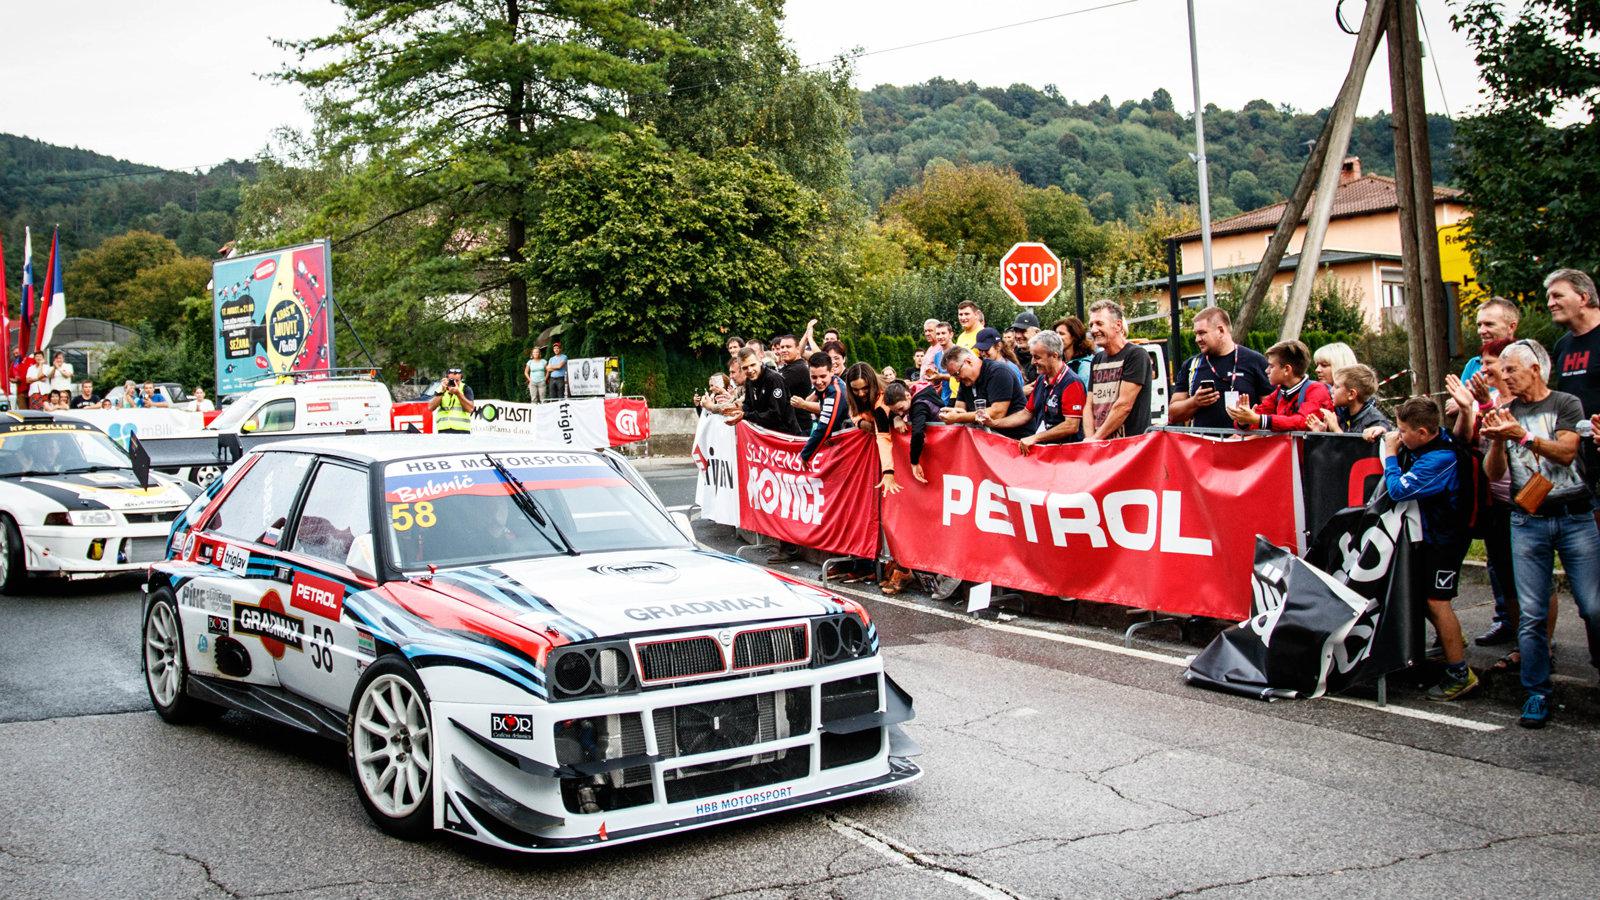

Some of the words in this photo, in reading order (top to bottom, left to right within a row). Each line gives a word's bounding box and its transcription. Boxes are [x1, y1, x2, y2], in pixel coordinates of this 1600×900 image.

[1005, 263, 1055, 286] STOP
[1562, 351, 1591, 372] HH
[406, 460, 452, 473] HBB
[460, 455, 591, 469] MOTORSPORT
[746, 465, 825, 526] NOVICE
[391, 501, 437, 532] 58
[942, 474, 1213, 557] PETROL
[224, 550, 247, 571] triglav
[296, 583, 338, 609] PETROL
[624, 596, 783, 621] GRADMAX
[240, 609, 300, 643] GRADMAX
[310, 624, 334, 673] 58
[695, 801, 719, 814] HBB
[721, 786, 793, 809] MOTORSPORT
